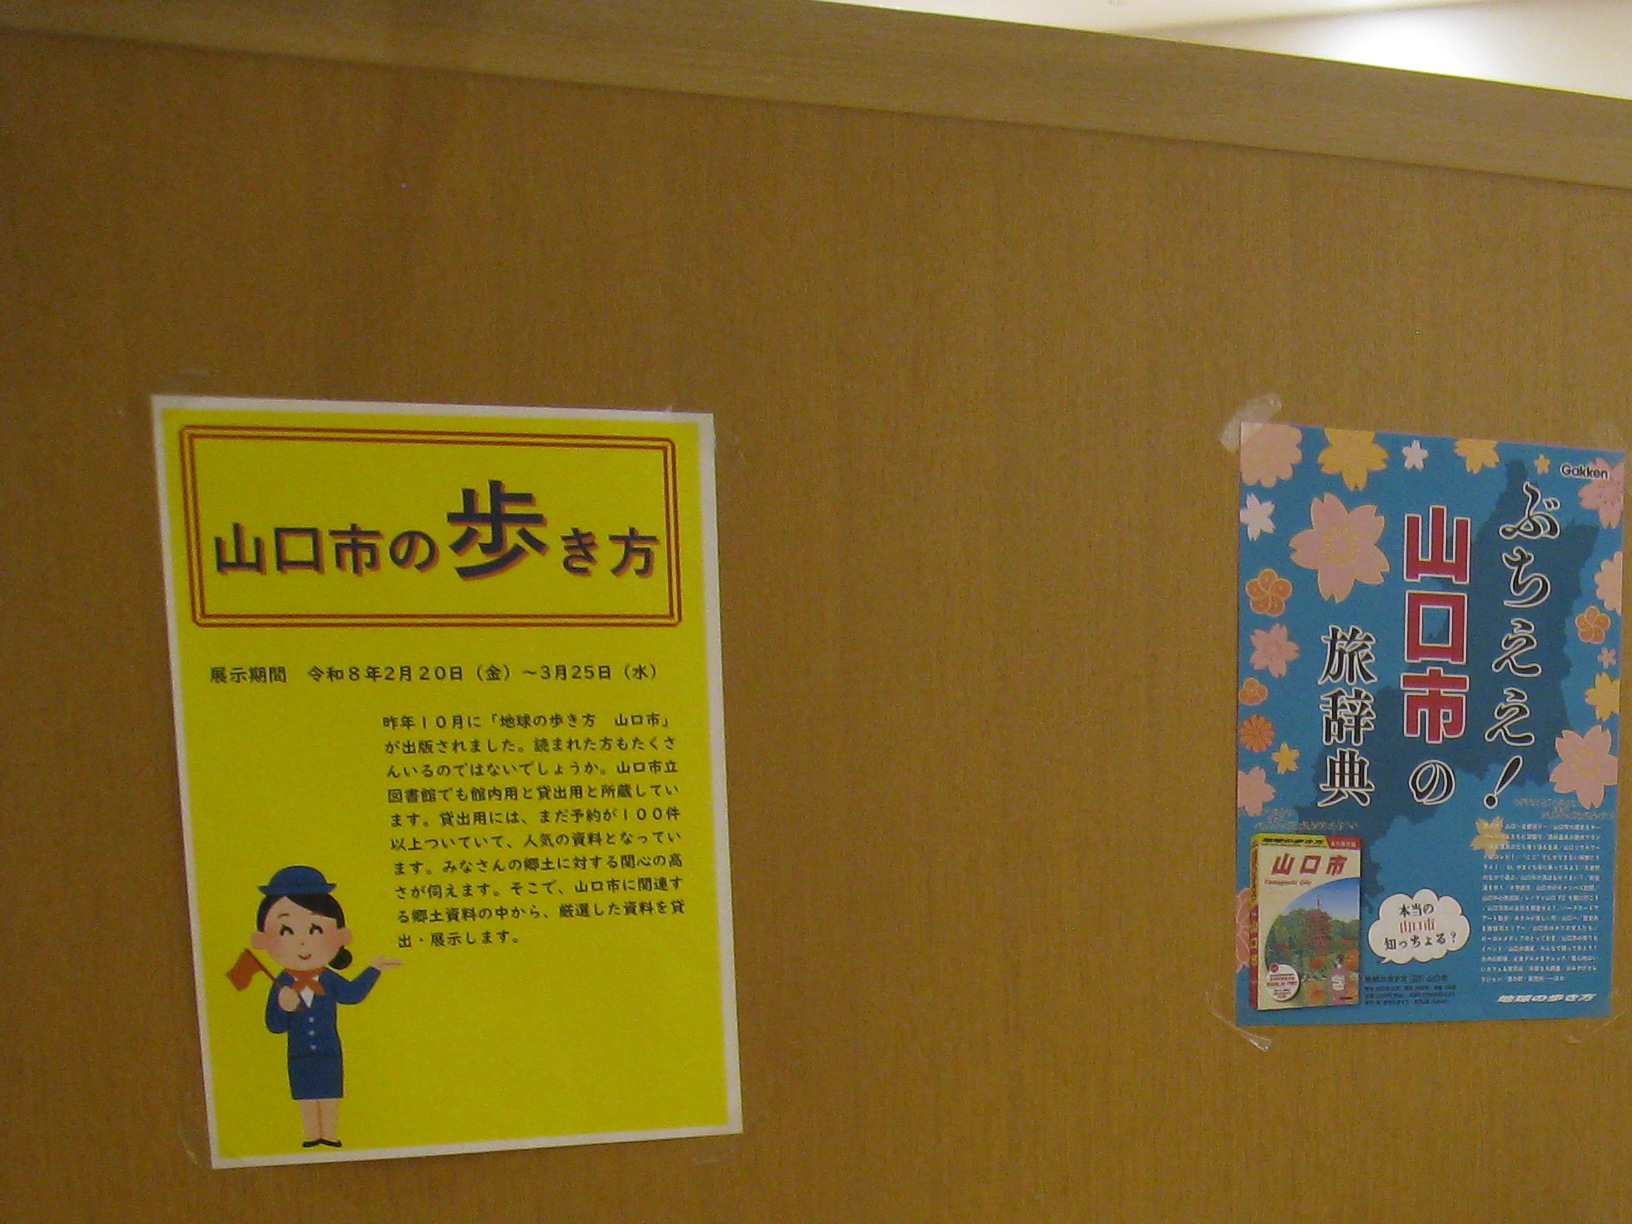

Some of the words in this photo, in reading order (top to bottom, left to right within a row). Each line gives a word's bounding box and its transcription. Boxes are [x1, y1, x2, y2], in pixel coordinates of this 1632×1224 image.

[1560, 464, 1608, 480] Gakken
[213, 480, 660, 581] 山口市の歩き方
[1400, 505, 1471, 805] 山口市の
[209, 666, 287, 684] 展示期間
[1317, 625, 1377, 807] 旅辞典
[385, 735, 677, 756] が出版されました。読まれた方もたくさ
[386, 758, 679, 780] んいるのではないでしょうか。山口市立
[1271, 853, 1348, 876] 山口市
[1399, 904, 1434, 918] 本当の
[1400, 919, 1434, 934] 山口市
